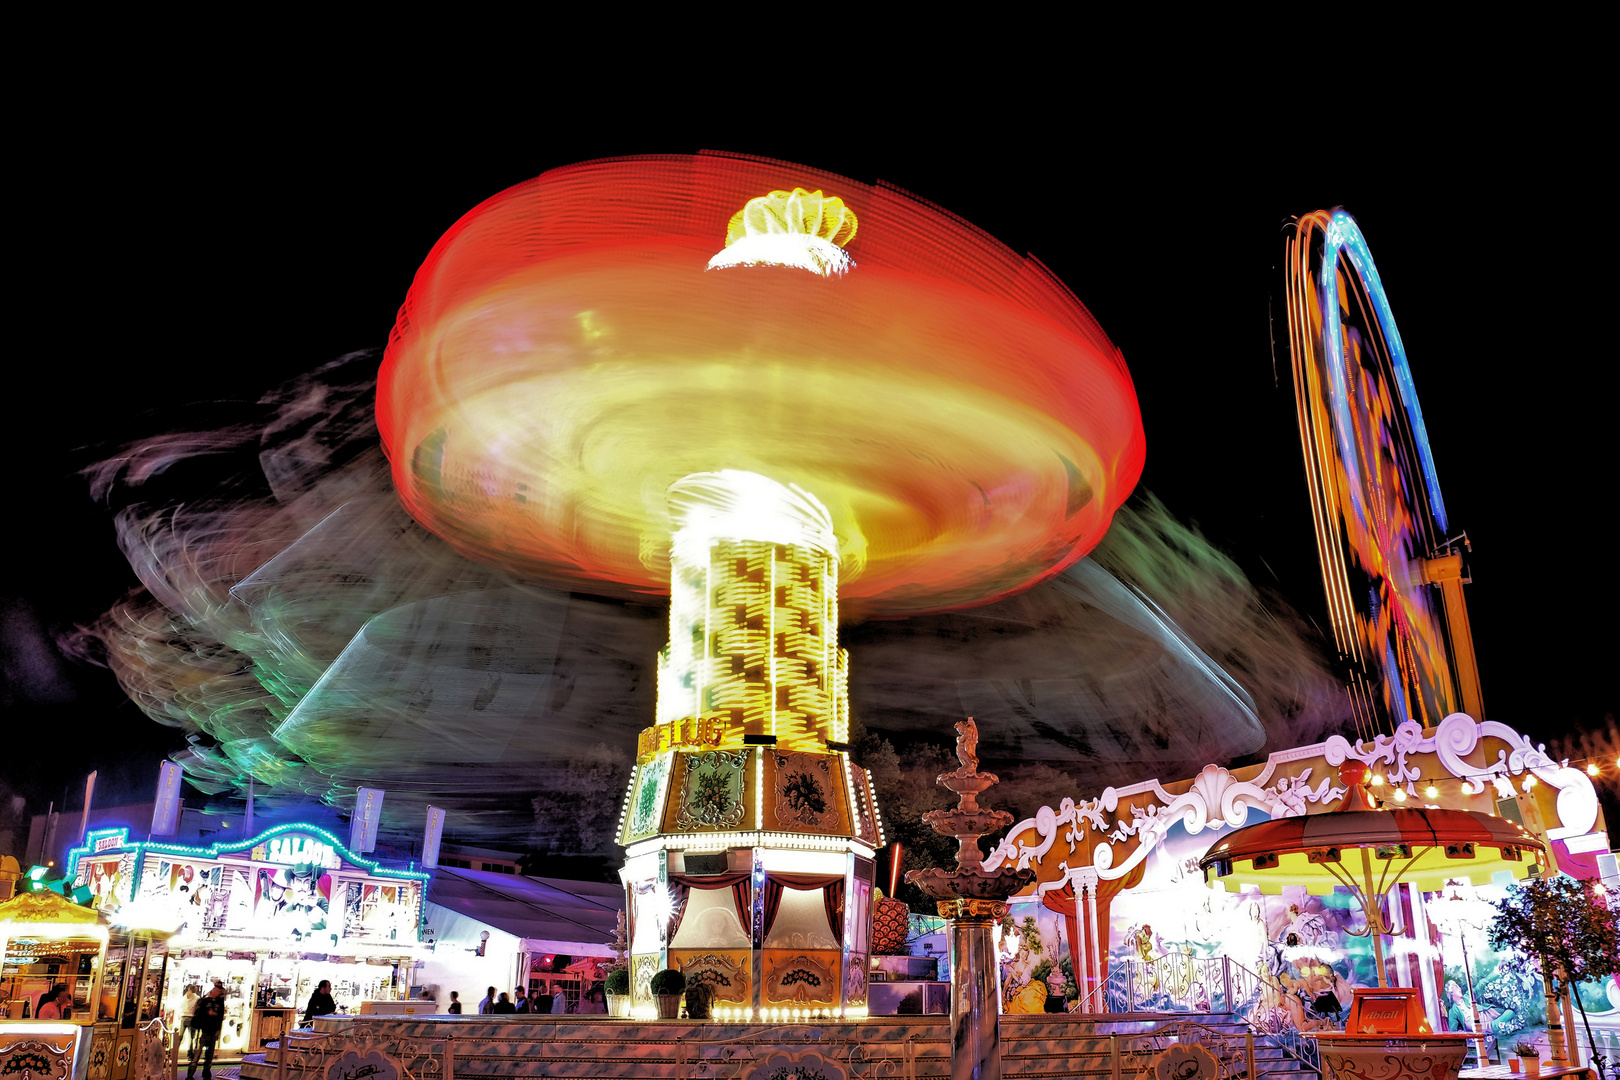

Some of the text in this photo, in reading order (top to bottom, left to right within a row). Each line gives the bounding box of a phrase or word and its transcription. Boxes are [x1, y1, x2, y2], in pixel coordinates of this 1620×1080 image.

[98, 836, 119, 850] SALOON
[269, 837, 334, 867] SALOON
[1365, 1011, 1399, 1019] Abfall
